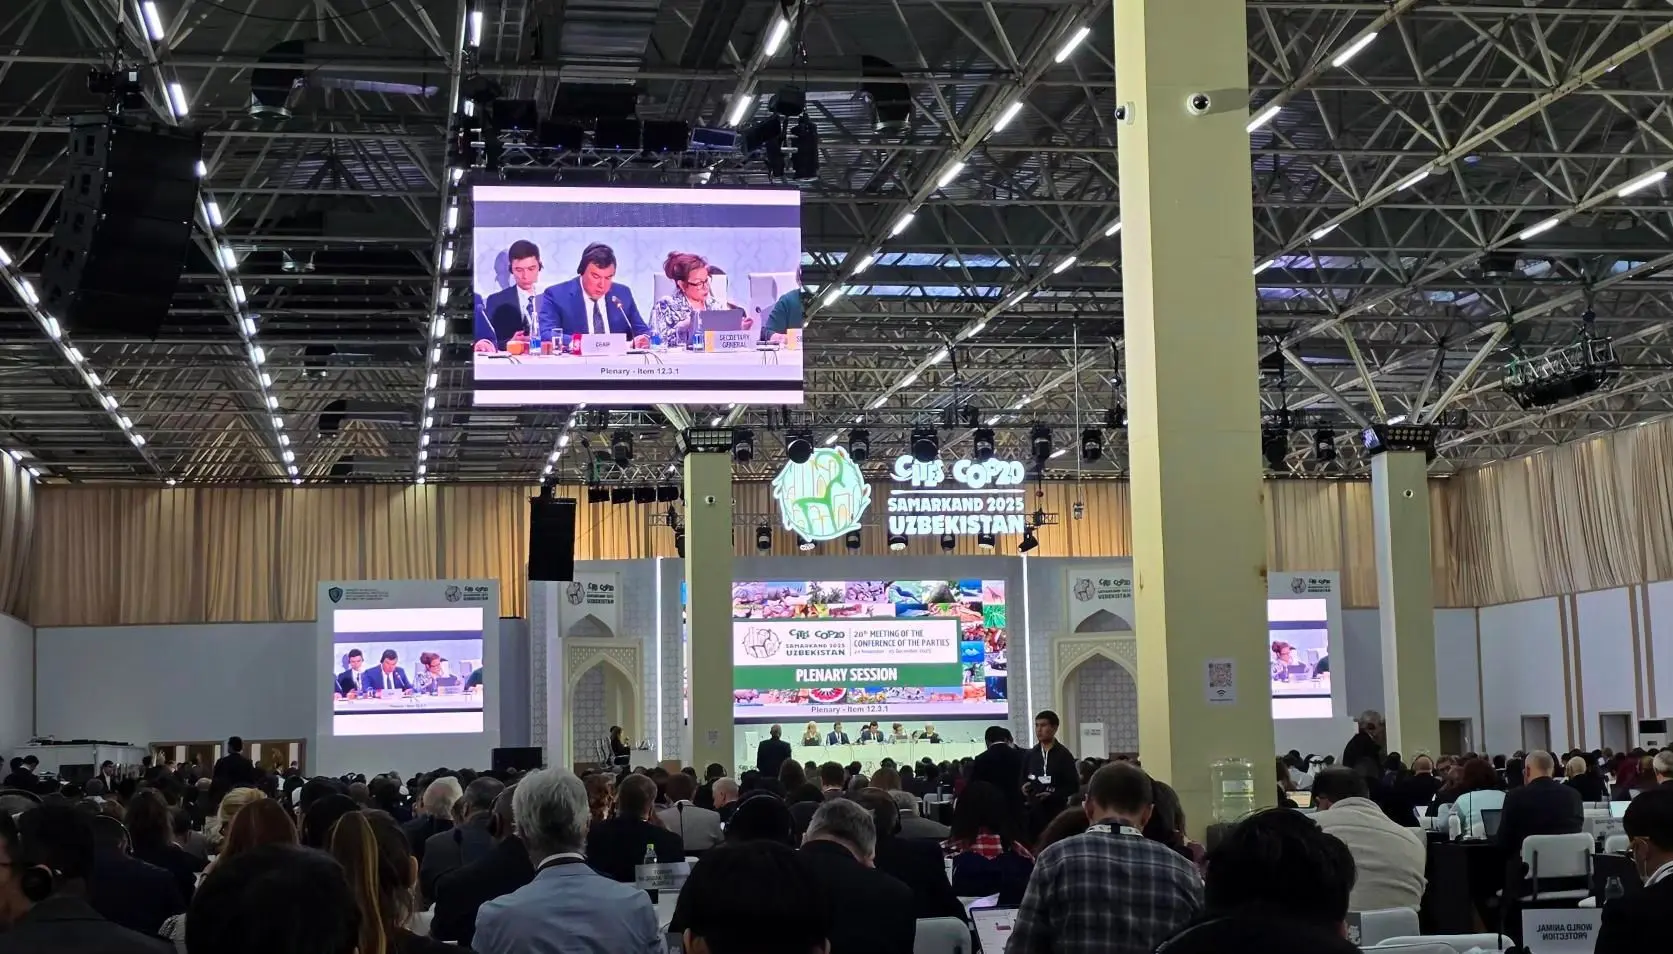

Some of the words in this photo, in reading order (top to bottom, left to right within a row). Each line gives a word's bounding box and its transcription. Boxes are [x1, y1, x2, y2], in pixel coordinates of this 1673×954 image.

[600, 367, 630, 376] Plenary
[637, 367, 655, 375] Item
[657, 367, 679, 375] 12.3.1
[890, 454, 945, 487] CITES
[952, 457, 1025, 489] COP20
[887, 497, 984, 512] SAMARKAND
[986, 497, 1025, 512] 2025
[888, 514, 1025, 535] UZBEKISTAN
[814, 629, 846, 640] COP20
[869, 629, 900, 638] MEETING
[900, 629, 910, 638] OF
[911, 629, 924, 638] THE
[853, 638, 895, 647] CONFERENCE
[897, 638, 906, 647] OF
[907, 638, 920, 647] THE
[921, 638, 950, 647] PARTIES
[795, 668, 848, 682] PLENARY
[849, 667, 898, 682] SESSION
[811, 705, 840, 714] Plenary
[847, 705, 864, 713] Item
[867, 705, 889, 713] 12.3.1
